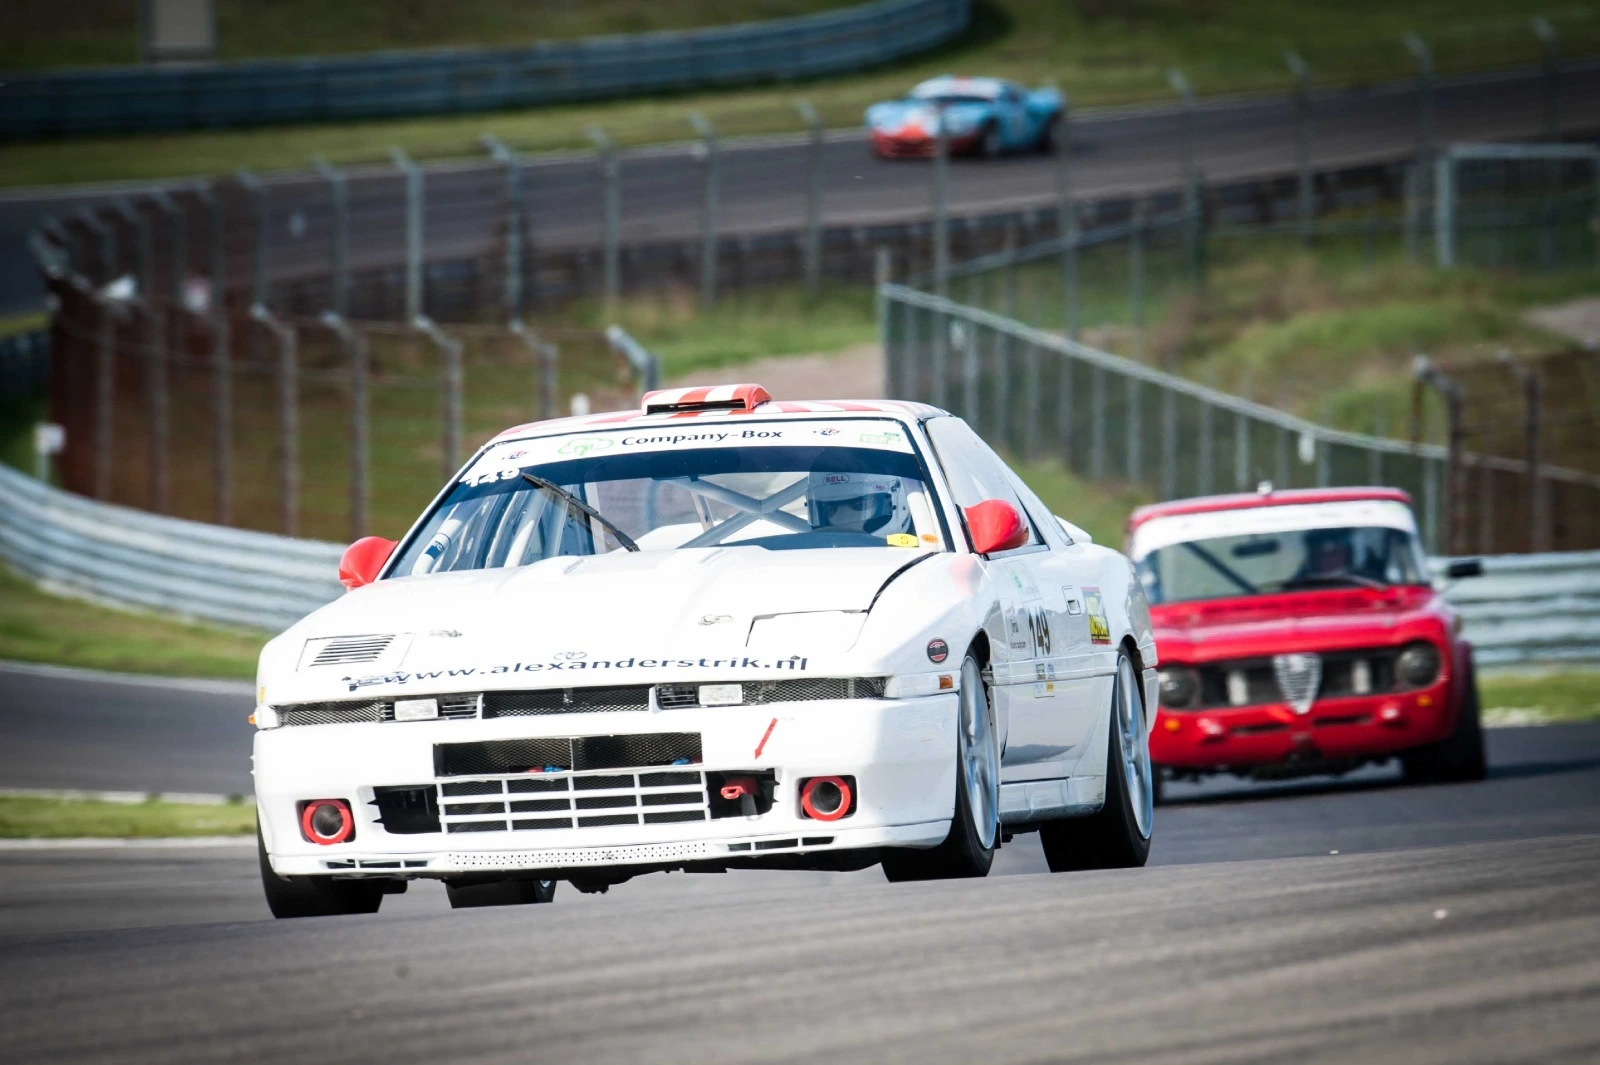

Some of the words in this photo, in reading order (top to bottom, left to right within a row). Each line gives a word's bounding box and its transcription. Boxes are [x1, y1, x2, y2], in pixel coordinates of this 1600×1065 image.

[622, 430, 783, 445] Company-Box
[825, 475, 846, 484] BELL
[1028, 605, 1051, 657] 149
[384, 657, 808, 683] www.alexanderstrik.nl
